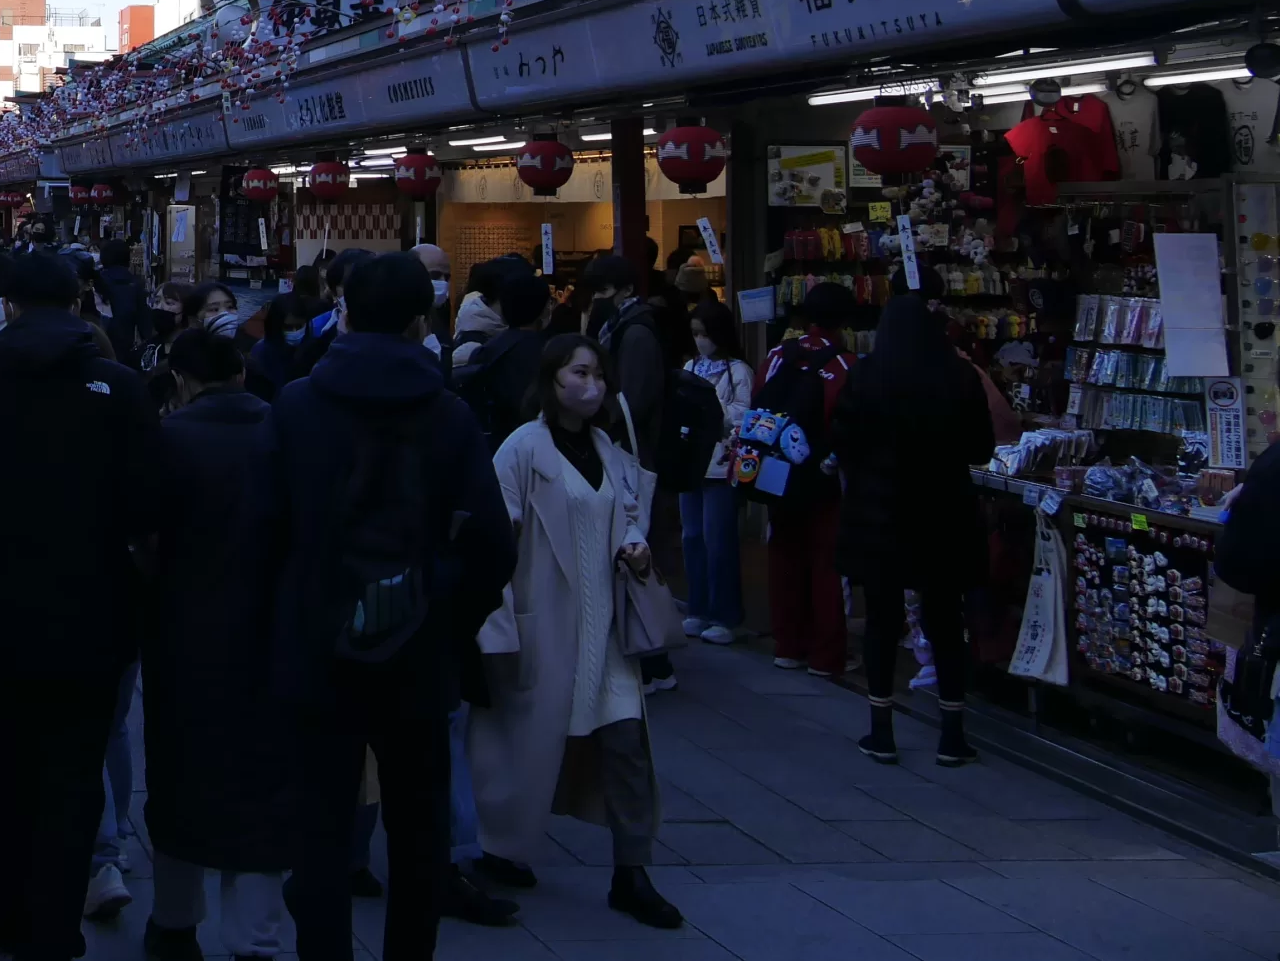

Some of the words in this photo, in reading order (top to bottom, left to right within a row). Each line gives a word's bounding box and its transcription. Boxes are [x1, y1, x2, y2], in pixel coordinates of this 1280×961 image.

[811, 11, 944, 48] FUKUMITSUYA
[517, 45, 565, 77] みつや
[387, 76, 436, 104] COSMETICS
